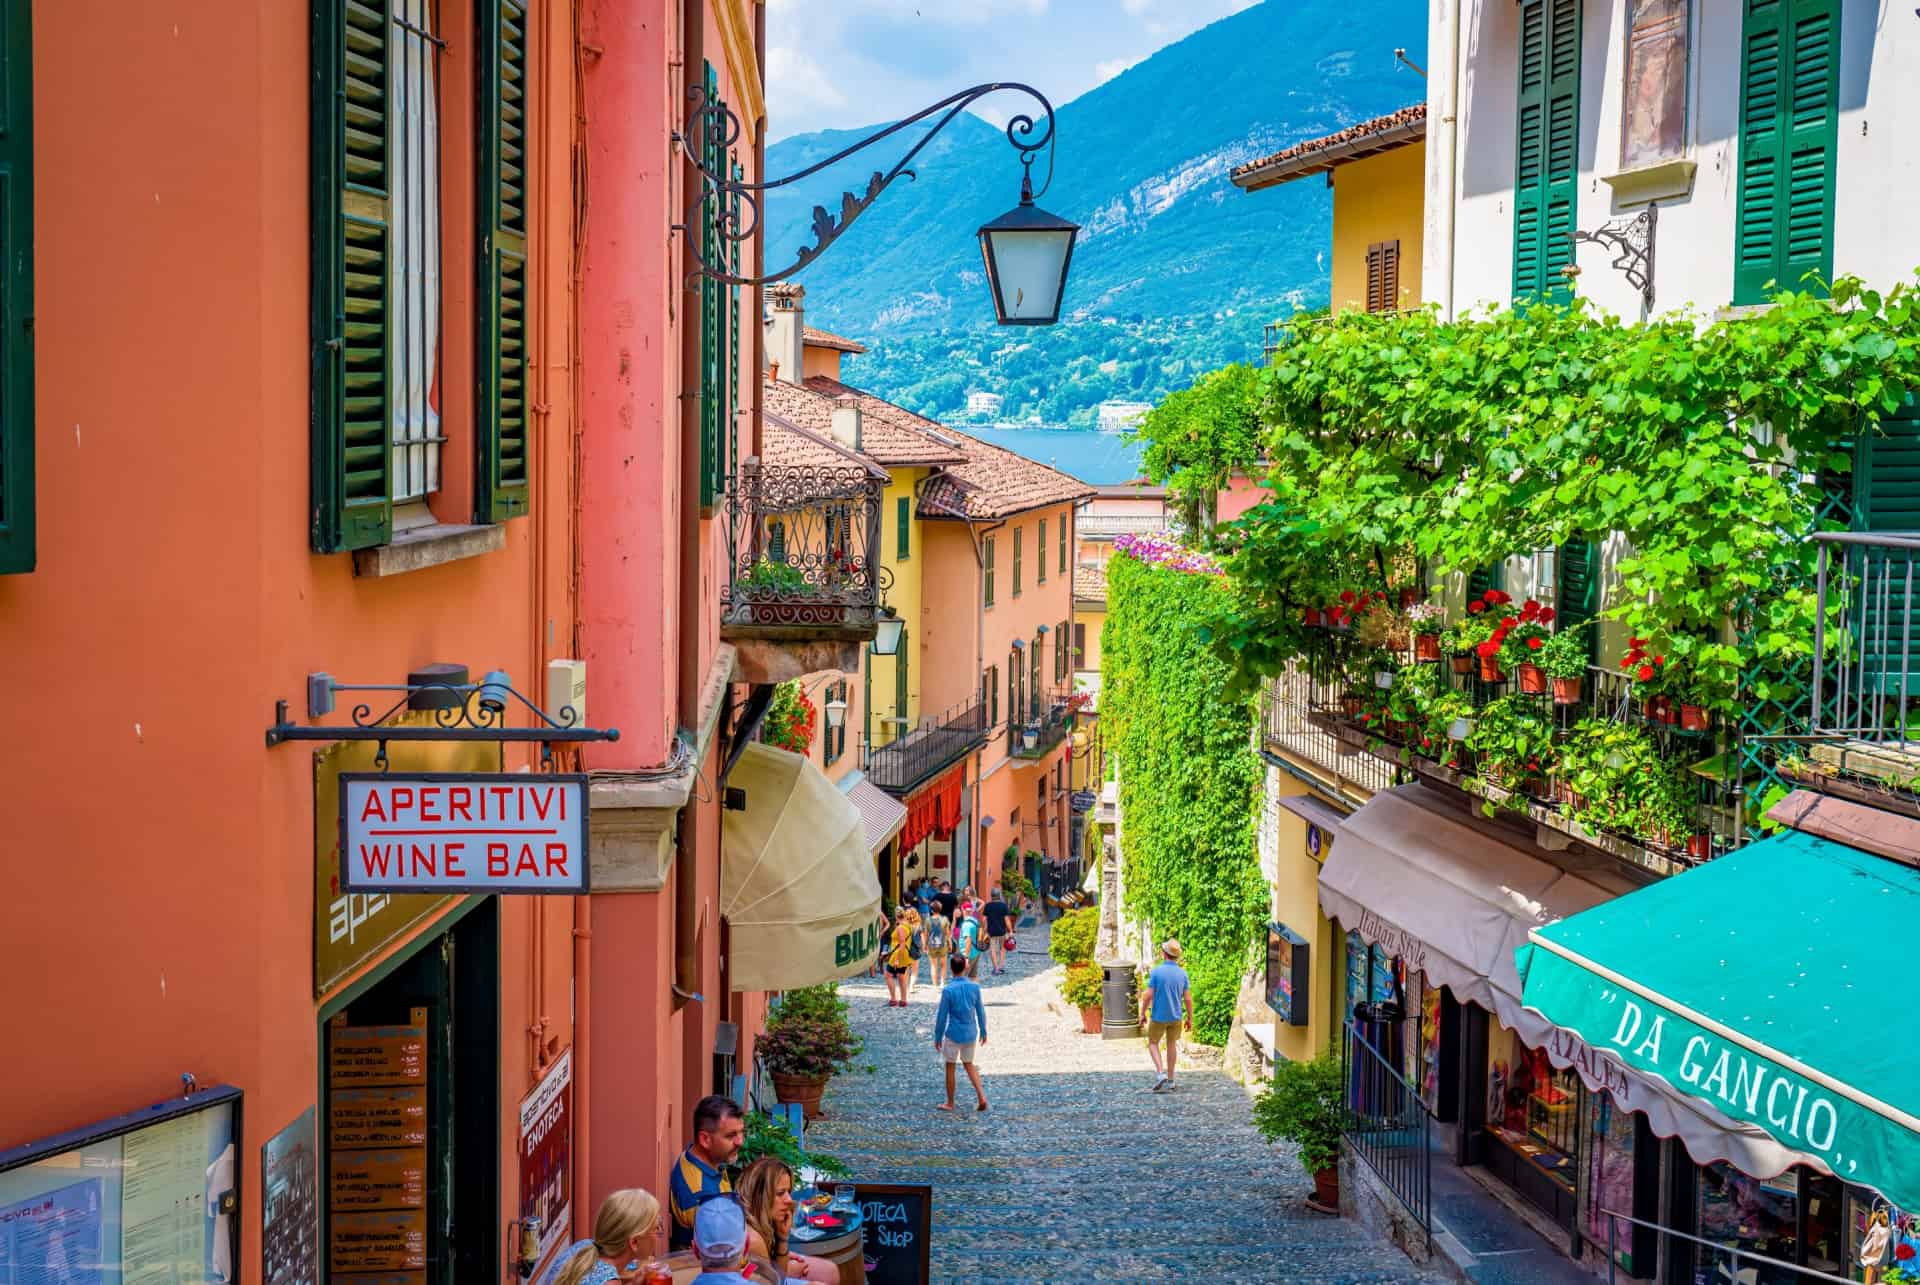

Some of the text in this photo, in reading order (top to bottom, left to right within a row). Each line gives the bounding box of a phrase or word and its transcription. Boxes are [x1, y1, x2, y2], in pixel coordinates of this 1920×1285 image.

[361, 787, 566, 822] APERITIVI
[360, 843, 568, 878] WINE BAR
[1360, 907, 1426, 968] Italian Style
[527, 1095, 565, 1158] ENOTECA
[878, 1224, 913, 1248] SHOP
